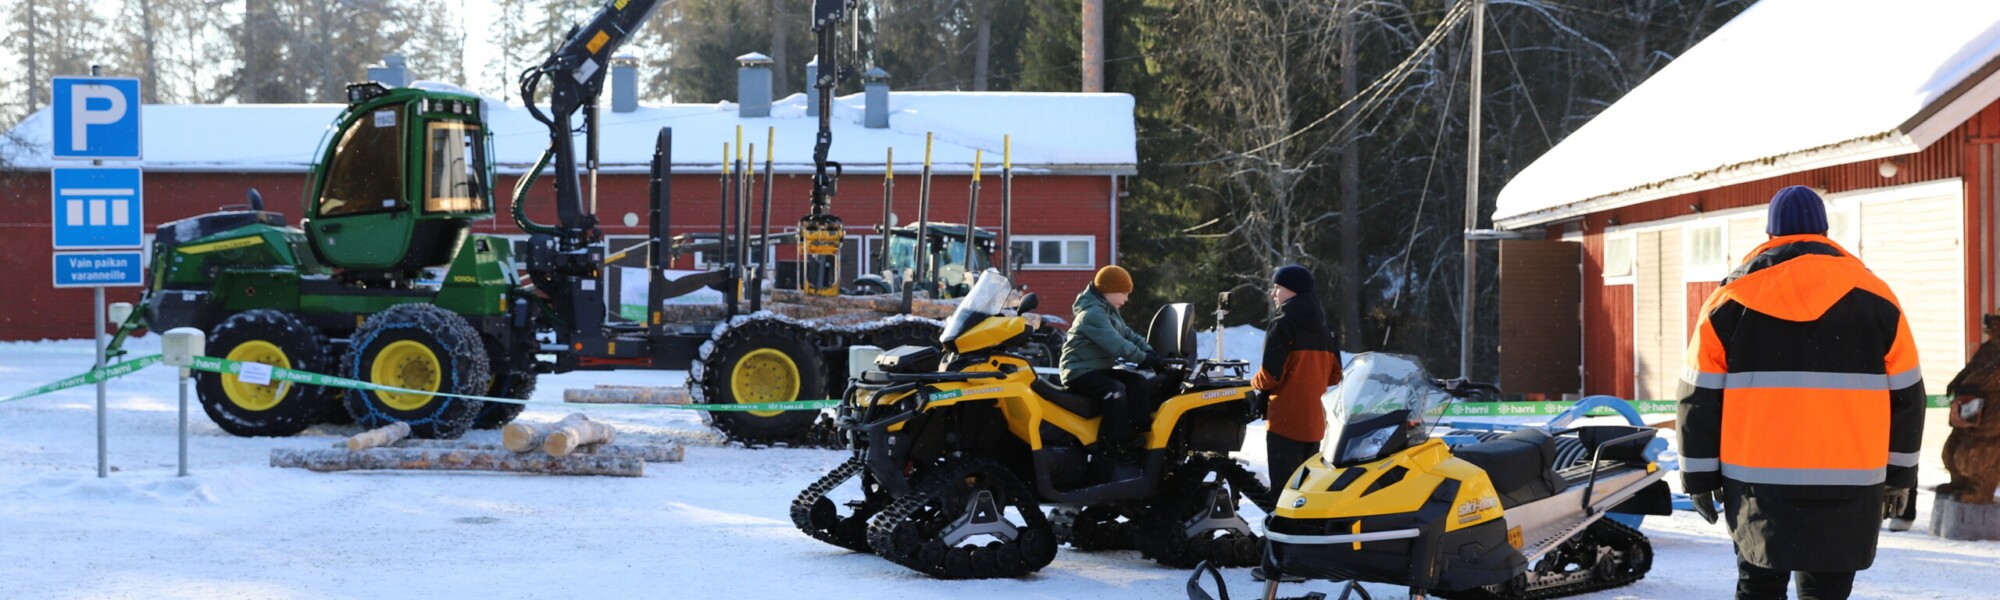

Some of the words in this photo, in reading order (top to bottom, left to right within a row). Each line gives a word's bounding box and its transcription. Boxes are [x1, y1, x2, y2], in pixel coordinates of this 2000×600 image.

[71, 84, 127, 151] P
[69, 258, 92, 268] Vain
[94, 257, 128, 268] paikan
[71, 271, 126, 281] varanneille
[106, 364, 131, 376] hami
[195, 360, 221, 370] hami
[61, 376, 86, 388] hami
[287, 373, 313, 382] hami
[938, 391, 957, 400] hami
[1465, 405, 1489, 414] hami
[1511, 404, 1535, 414] hami
[1458, 497, 1498, 516] ski-doo
